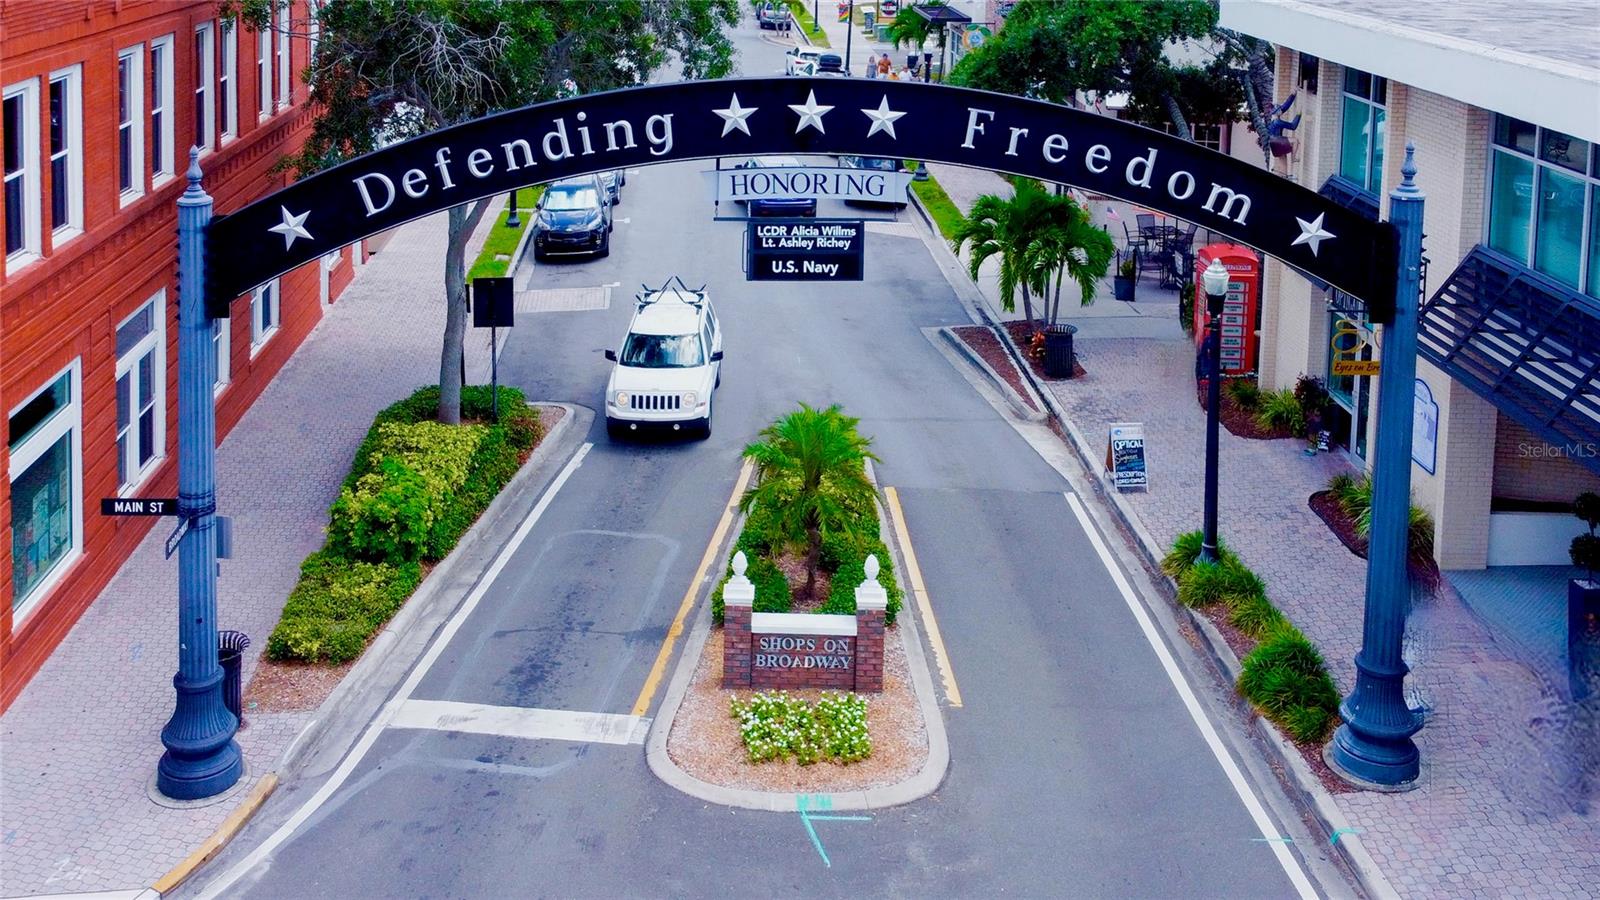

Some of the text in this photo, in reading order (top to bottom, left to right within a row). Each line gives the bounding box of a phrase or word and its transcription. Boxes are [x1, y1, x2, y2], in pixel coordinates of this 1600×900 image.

[352, 107, 1251, 226] Defending Freedom
[731, 172, 885, 196] HONORING
[757, 225, 856, 236] LCDR Alicia Willms
[762, 238, 851, 250] Lt. Ashley Richey
[772, 261, 839, 277] U.S. Navy
[1335, 363, 1353, 374] Eyes
[1114, 440, 1144, 451] OPTICAL
[114, 502, 164, 513] MAIN ST
[760, 638, 849, 653] SHOPS ON
[756, 654, 852, 669] BROADWAY
